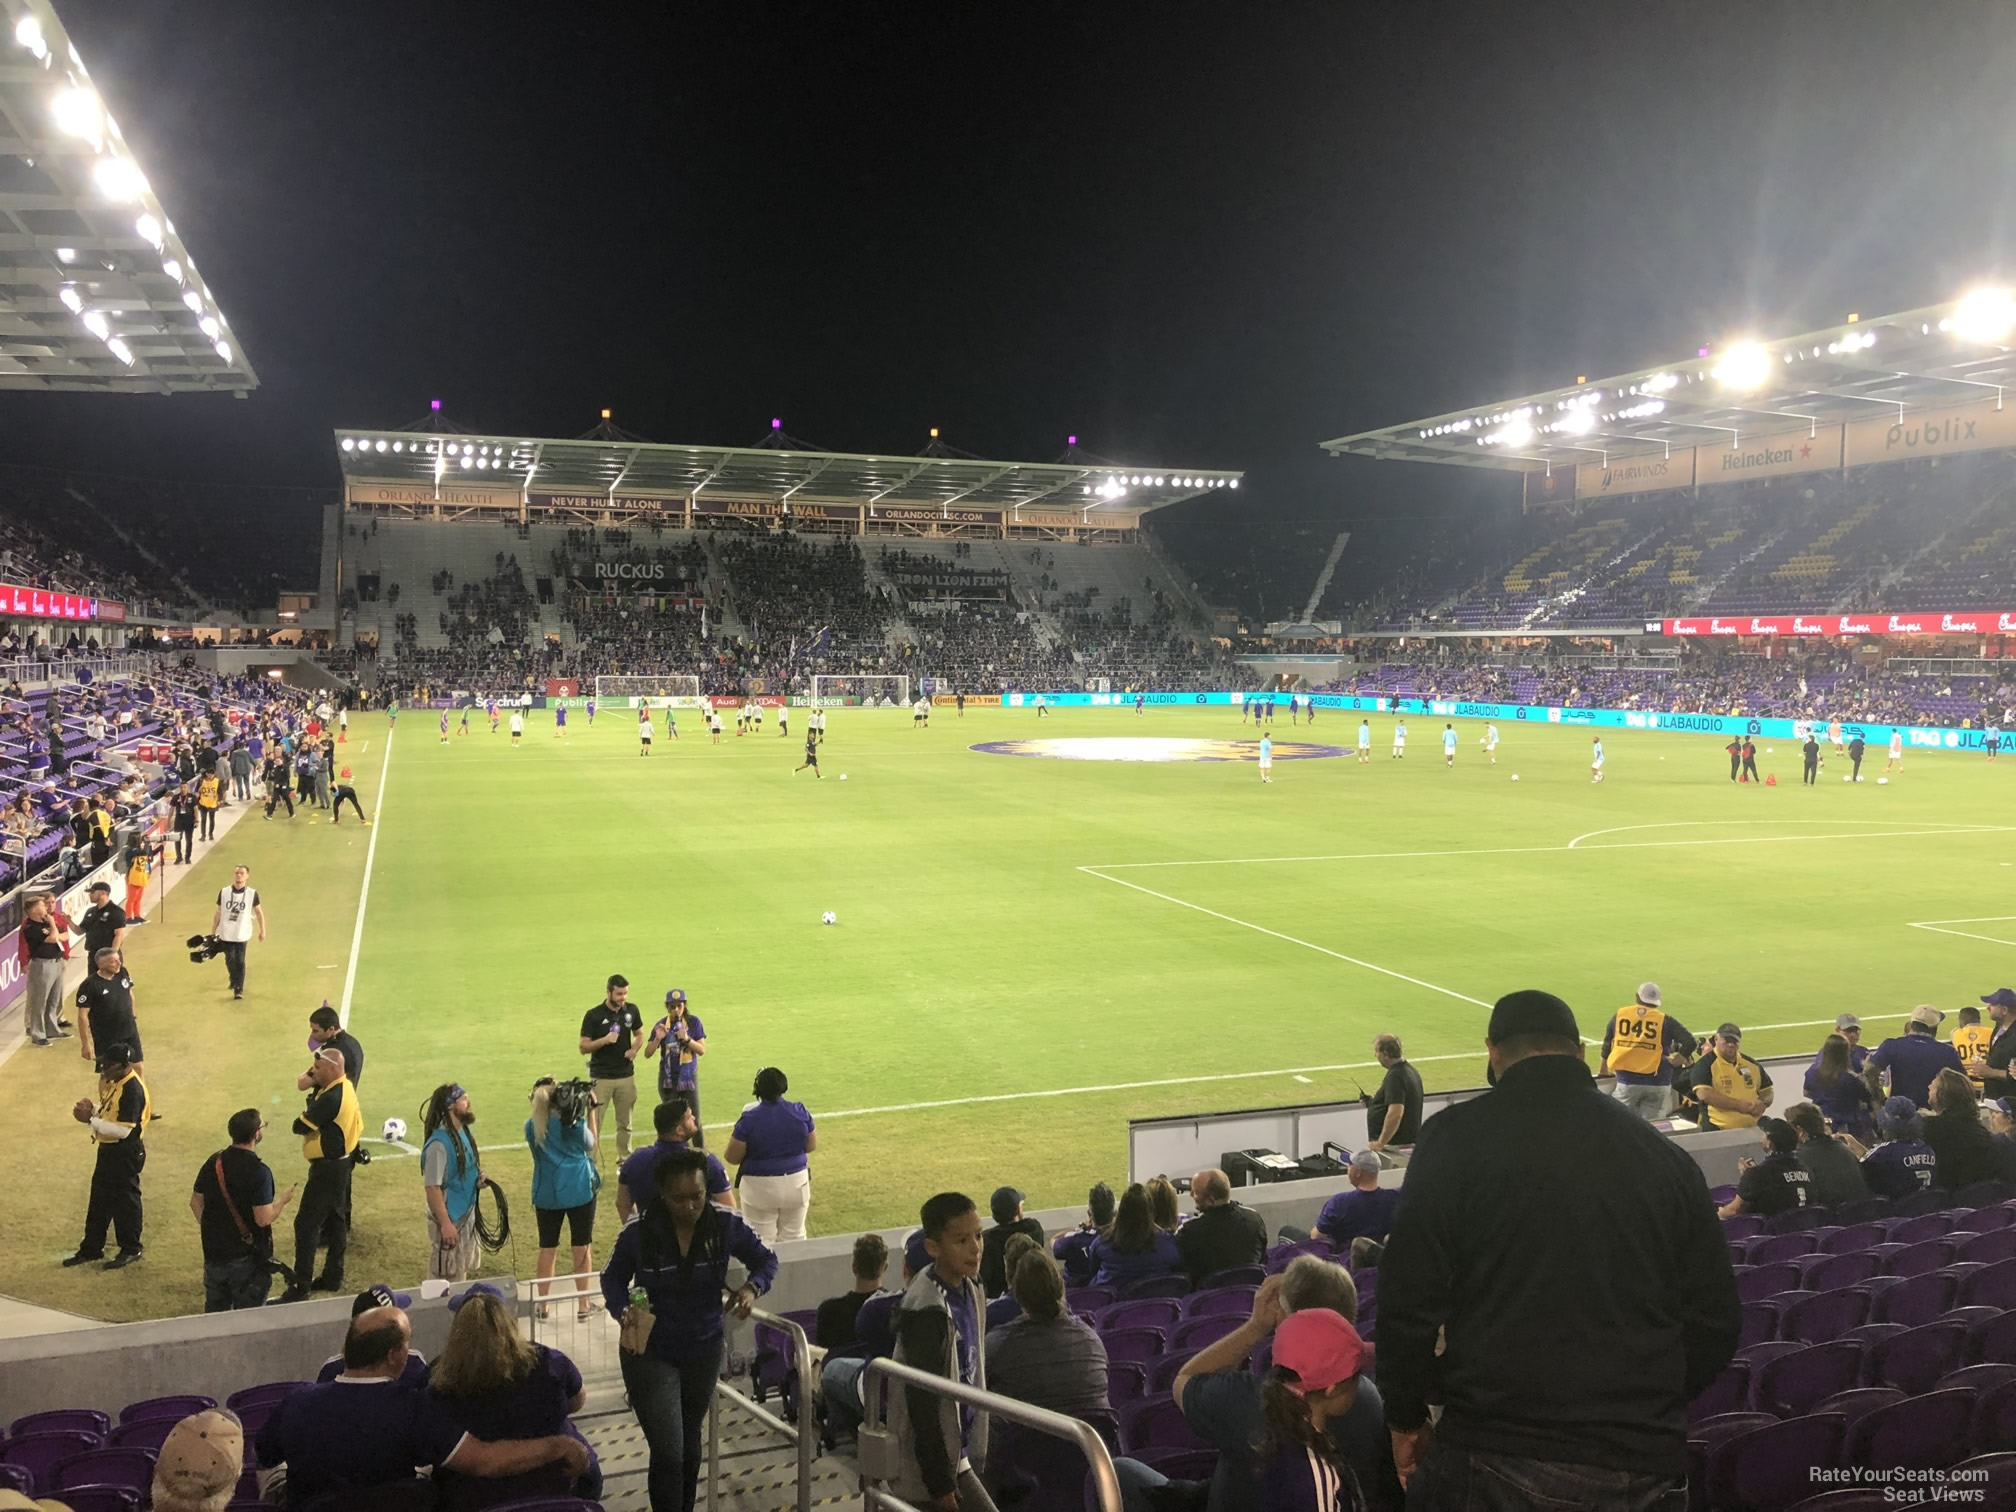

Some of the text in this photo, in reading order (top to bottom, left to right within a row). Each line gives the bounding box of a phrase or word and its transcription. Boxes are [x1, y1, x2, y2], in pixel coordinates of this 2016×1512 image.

[1886, 417, 1977, 450] Publix
[1722, 448, 1793, 471] Heineken
[1613, 463, 1668, 481] FAIRWINDS
[551, 497, 588, 507] NEVER
[624, 500, 662, 509] ALONE
[727, 503, 760, 514] MAN
[792, 505, 827, 517] WALL
[595, 563, 665, 579] RUCKUS
[936, 575, 971, 586] LION
[973, 576, 1008, 587] FIRM
[716, 698, 737, 706] Audi
[1908, 730, 1941, 747] TAG
[226, 900, 246, 911] 029
[1618, 1018, 1658, 1039] 045
[1903, 1154, 1936, 1168] CANFIELD
[1915, 1170, 1932, 1191] 7
